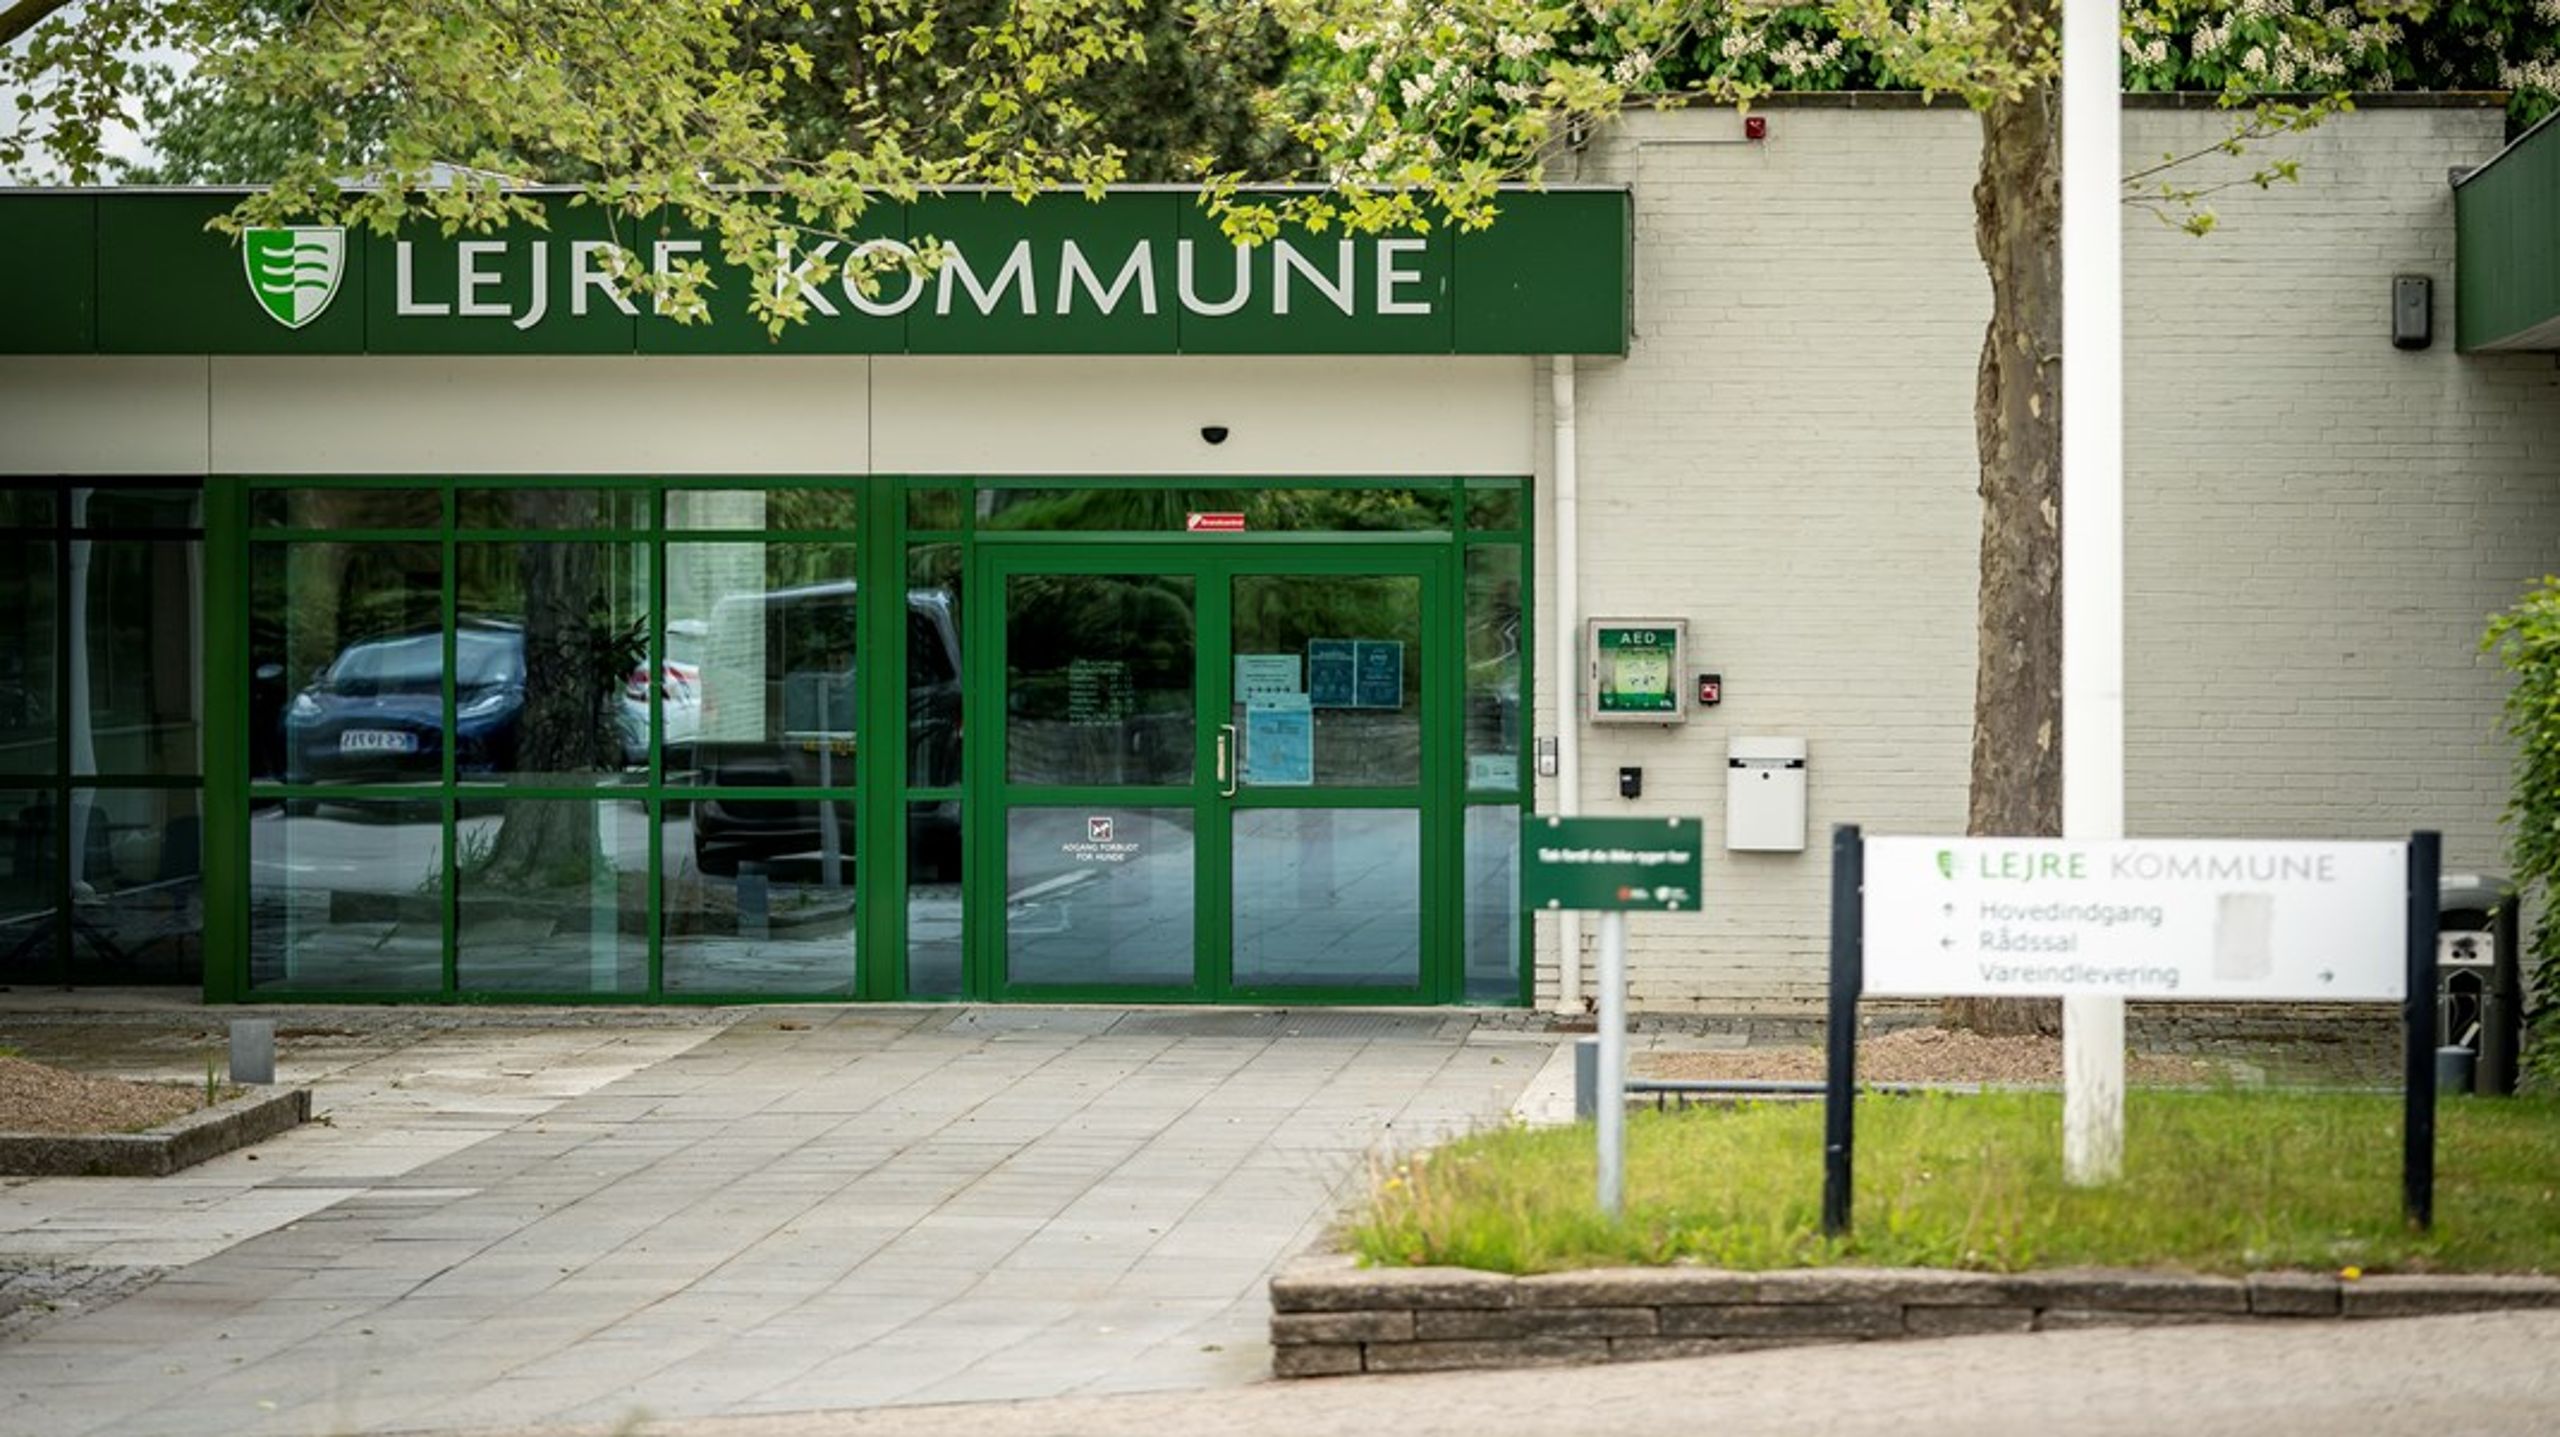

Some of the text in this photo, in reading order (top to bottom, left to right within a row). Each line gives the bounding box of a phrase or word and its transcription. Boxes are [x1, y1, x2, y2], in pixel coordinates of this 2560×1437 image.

[396, 239, 1432, 330] LEJRE KOMMUNE
[1620, 632, 1656, 645] AED
[1062, 843, 1139, 852] ADGANG FORBUDT
[1076, 853, 1125, 862] FOR HUNDE
[1979, 852, 2335, 882] LEJRE KOMMUNE
[1979, 902, 2163, 927] Hovedindgang
[1979, 927, 2078, 952] Rådssal
[1979, 963, 2181, 988] Vareindlevering
